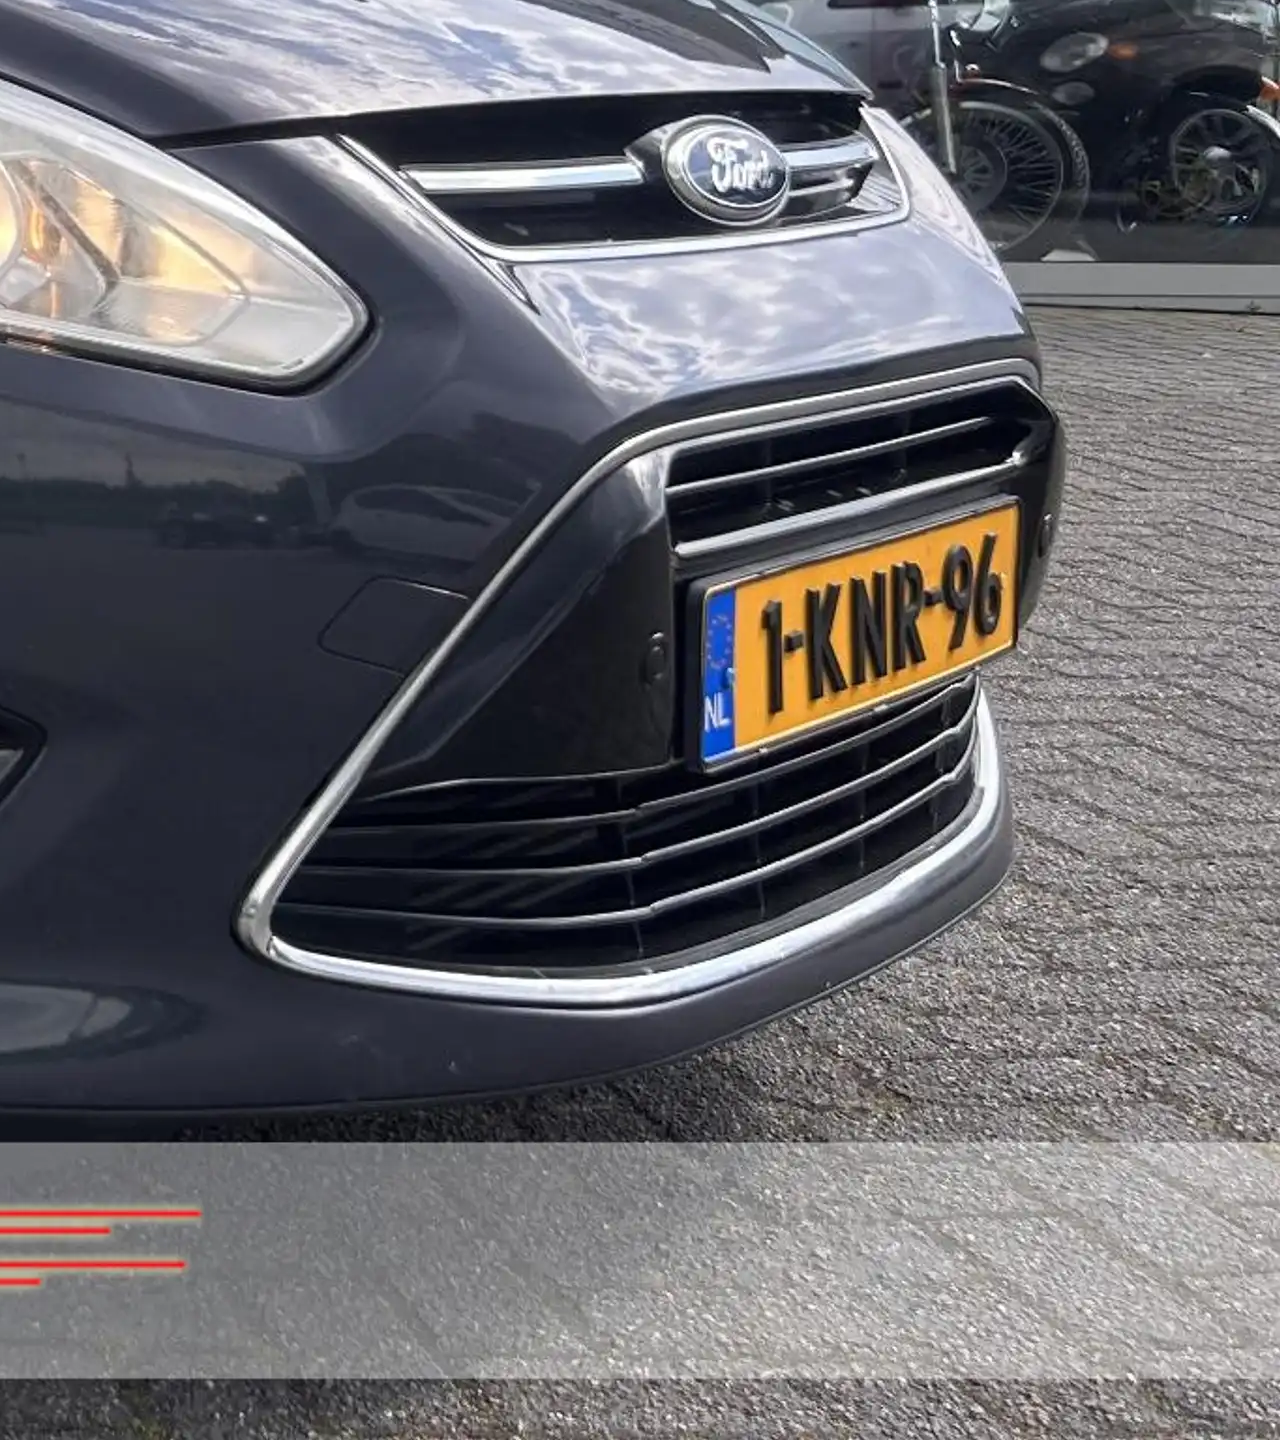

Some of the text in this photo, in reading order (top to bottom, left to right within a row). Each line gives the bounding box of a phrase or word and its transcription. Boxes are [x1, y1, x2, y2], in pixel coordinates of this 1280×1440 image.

[705, 136, 775, 192] Ford
[761, 532, 1004, 715] 1-KNR-96
[704, 691, 730, 733] NL
